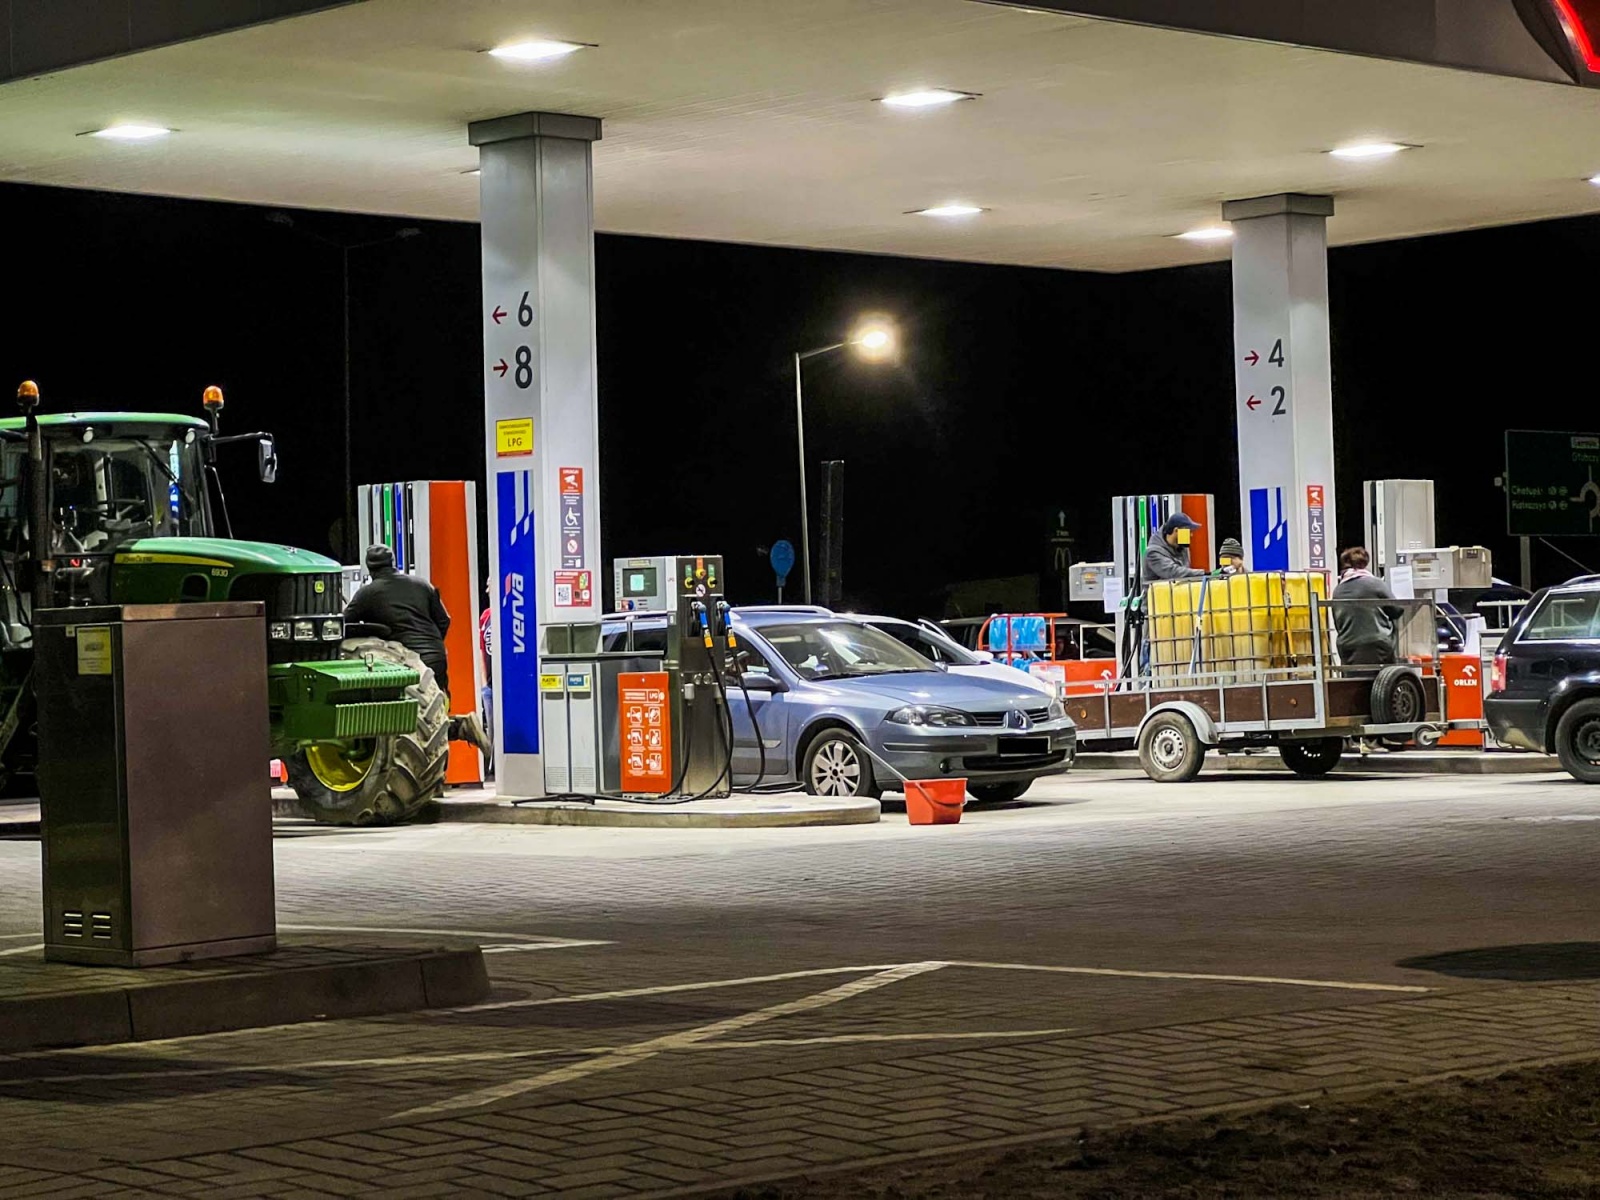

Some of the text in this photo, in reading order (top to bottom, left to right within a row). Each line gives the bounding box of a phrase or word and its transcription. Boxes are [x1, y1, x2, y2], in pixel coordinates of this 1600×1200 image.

[517, 290, 533, 327] 6
[514, 345, 533, 389] 8
[1268, 338, 1284, 367] 4
[1271, 386, 1286, 415] 2
[507, 437, 523, 447] LPG
[511, 572, 525, 654] verva
[1453, 679, 1478, 687] ORLEN
